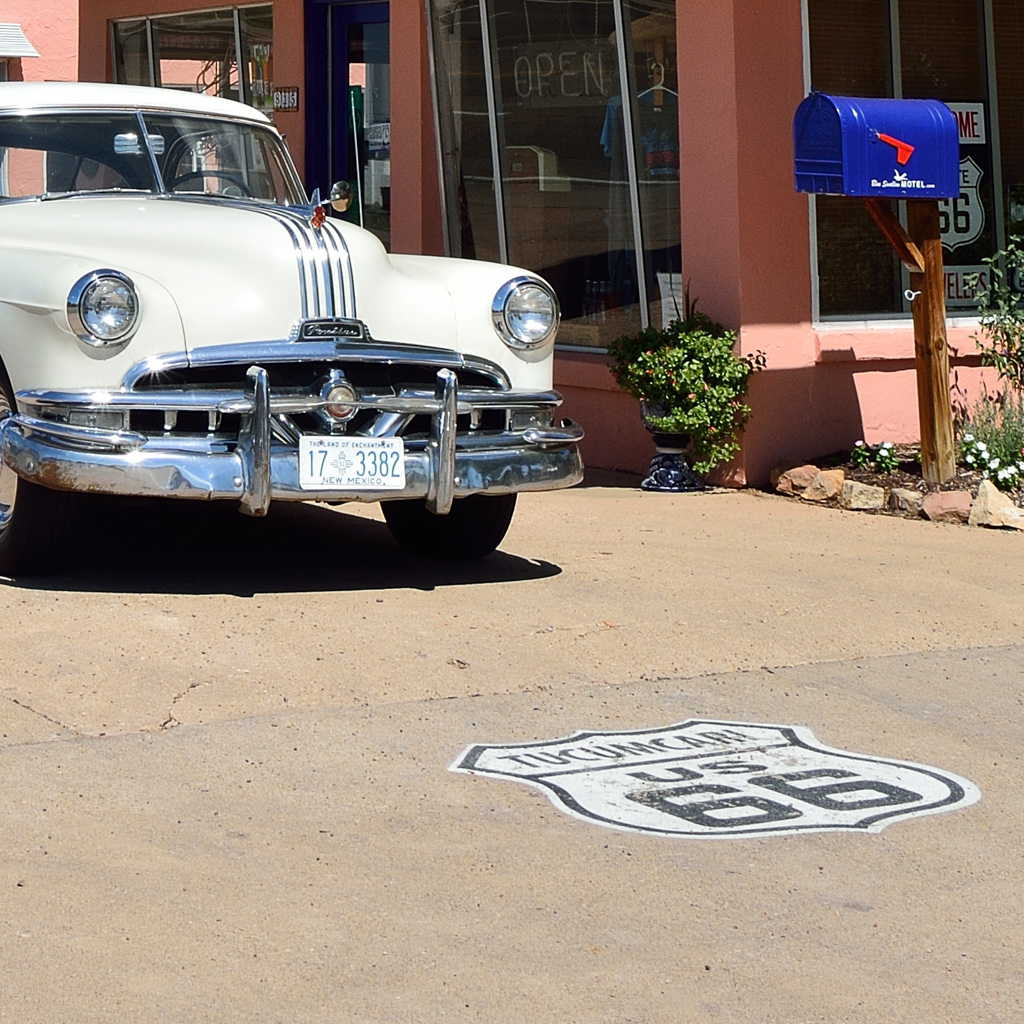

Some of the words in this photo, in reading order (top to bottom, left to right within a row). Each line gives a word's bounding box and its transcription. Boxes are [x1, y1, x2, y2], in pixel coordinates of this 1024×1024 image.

[514, 52, 608, 97] OPEN
[351, 441, 394, 449] ENCHANTMENT
[309, 450, 328, 477] 17
[356, 450, 401, 478] 3382
[347, 477, 382, 485] MEXICO
[496, 728, 759, 769] TUCUMCARI
[624, 760, 768, 783] US
[624, 768, 924, 828] 66
